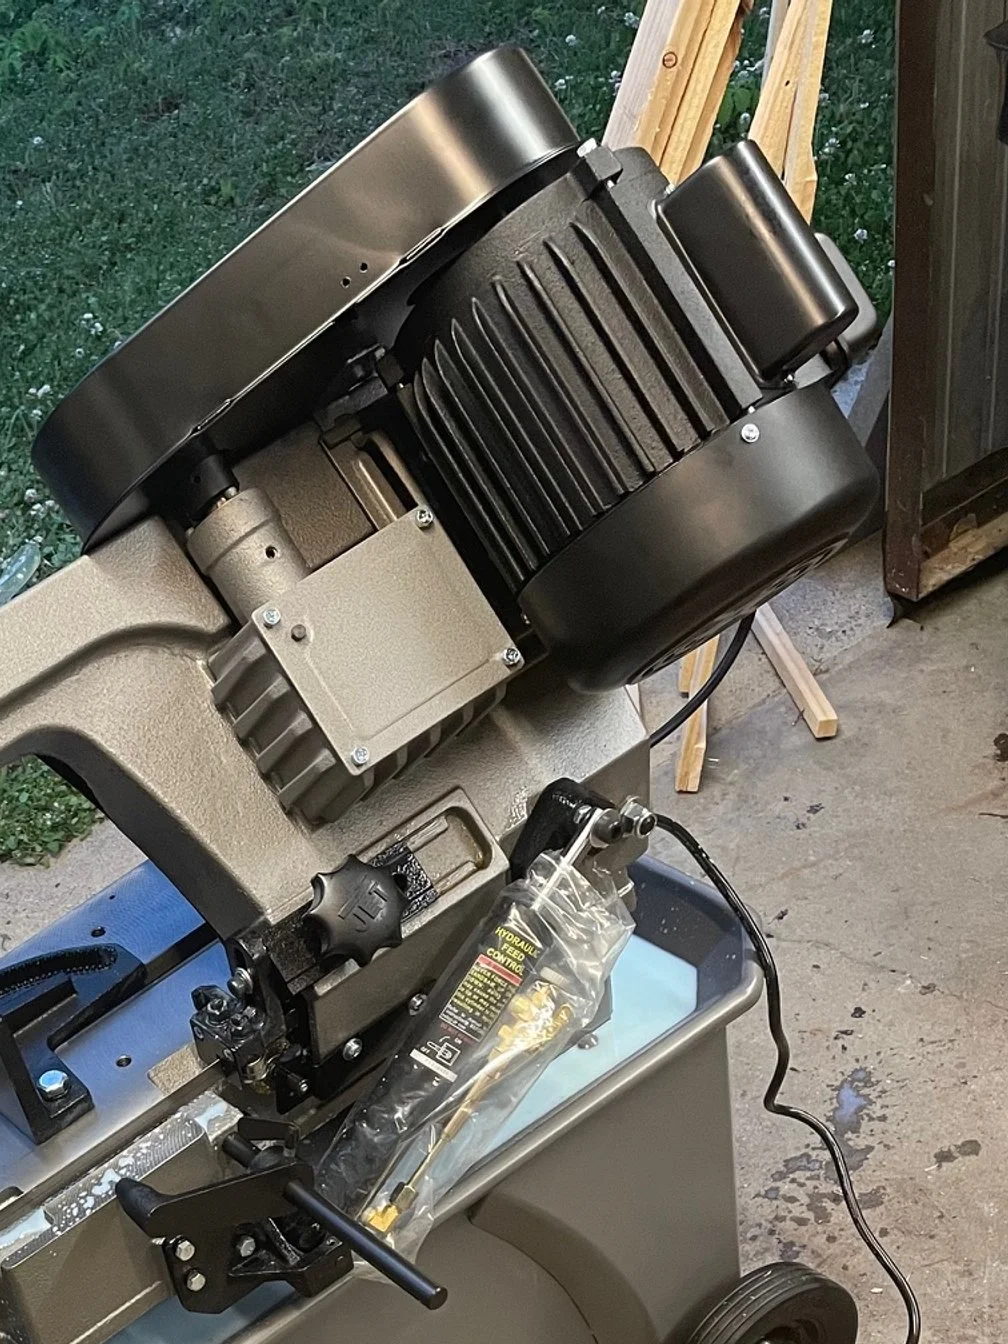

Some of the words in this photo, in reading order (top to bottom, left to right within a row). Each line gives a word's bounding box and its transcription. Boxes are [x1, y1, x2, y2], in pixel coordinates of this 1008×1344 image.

[354, 879, 389, 933] JET
[486, 947, 525, 976] CONTROL
[501, 943, 525, 962] FEED
